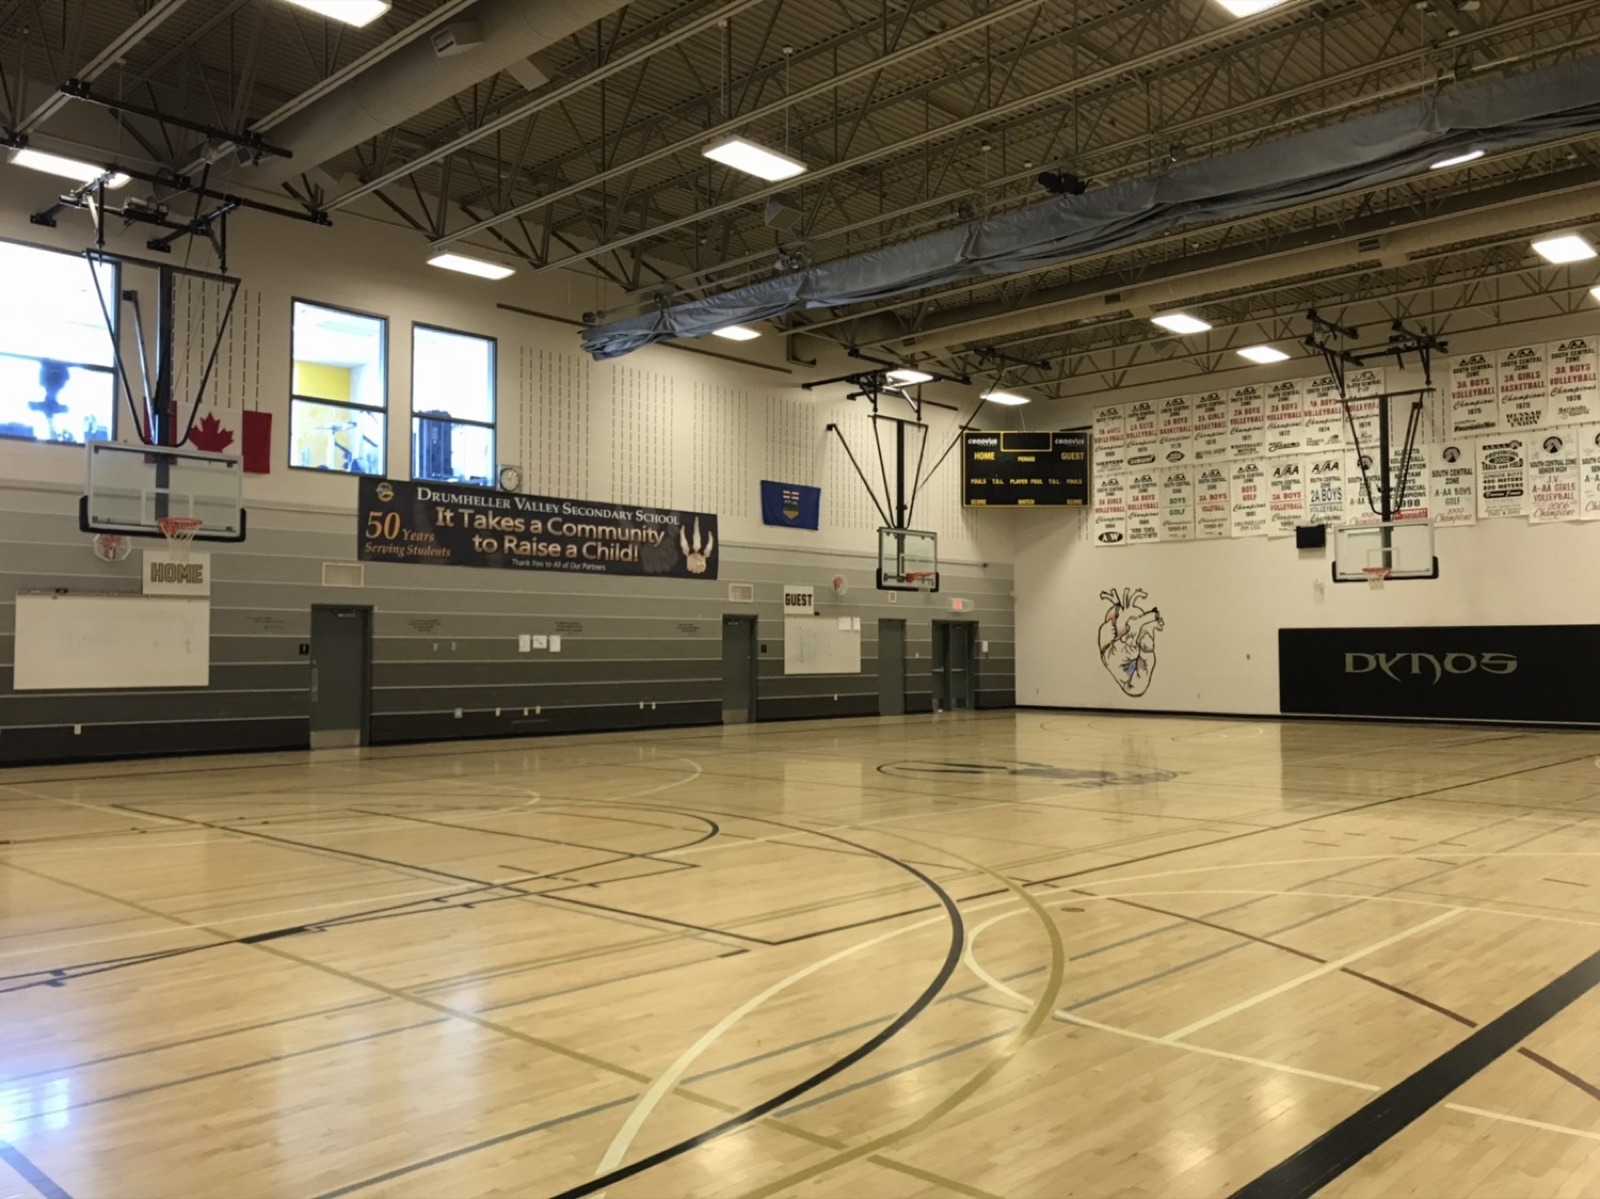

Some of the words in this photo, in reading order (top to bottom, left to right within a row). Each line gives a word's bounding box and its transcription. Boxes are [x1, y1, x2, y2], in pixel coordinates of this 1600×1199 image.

[1570, 348, 1595, 356] CENTRAL
[1570, 364, 1590, 372] BOYS
[1518, 371, 1541, 380] GIRLS
[1550, 373, 1597, 385] VOLLEYBALL
[1470, 378, 1490, 386] BOYS
[1501, 381, 1545, 393] BASKETBALL
[1452, 387, 1495, 399] VOLLEYBALL
[1245, 407, 1260, 415] BOYS
[1281, 403, 1297, 411] BOYS
[1208, 412, 1224, 420] GIRLS
[1267, 412, 1301, 421] VOLLEYBALL
[1304, 408, 1341, 417] VOLLEYBALL
[1230, 415, 1264, 425] VOLLEYBALL
[1195, 421, 1226, 431] BASKETBALL
[1126, 430, 1157, 439] VOLLEYBALL
[974, 452, 995, 460] HOME
[1061, 452, 1084, 460] GUEST
[1432, 469, 1448, 478] SOUTH
[1450, 468, 1473, 476] CENTRAL
[1445, 477, 1459, 485] ZONE
[1241, 485, 1257, 493] BOYS
[1454, 487, 1471, 495] BOYS
[1554, 482, 1575, 492] GIRLS
[1311, 489, 1320, 502] 2A
[1322, 487, 1342, 501] BOYS
[1534, 492, 1574, 501] VOLLEYBALL
[1169, 497, 1186, 505] BOYS
[1445, 497, 1460, 505] GOLF
[417, 487, 511, 509] DRUMHELLER
[514, 497, 560, 514] VALLEY
[562, 502, 633, 521] SECONDARY
[635, 510, 679, 526] SCHOOL
[1095, 506, 1125, 514] VOLLEYBALL
[1128, 502, 1159, 511] VOLLEYBALL
[1270, 503, 1303, 511] VOLLEYBALL
[1310, 505, 1343, 513] VOLLEYBALL
[1169, 508, 1185, 516] GOLF
[365, 510, 400, 540] 50
[402, 529, 435, 542] Years
[436, 506, 454, 527] It
[458, 508, 525, 532] Takes
[530, 519, 542, 533] a
[547, 517, 665, 548] Community
[365, 543, 405, 558] Serving
[407, 544, 451, 558] Students
[473, 533, 498, 553] to
[504, 535, 561, 558] Raise
[565, 545, 577, 558] a
[582, 541, 639, 562] Child!
[512, 558, 530, 567] Thank
[532, 559, 544, 568] You
[545, 560, 552, 568] to
[553, 560, 561, 568] All
[562, 560, 569, 569] of
[570, 561, 581, 570] Our
[582, 562, 606, 571] Partners
[150, 562, 203, 584] HOME
[785, 593, 812, 606] GUEST
